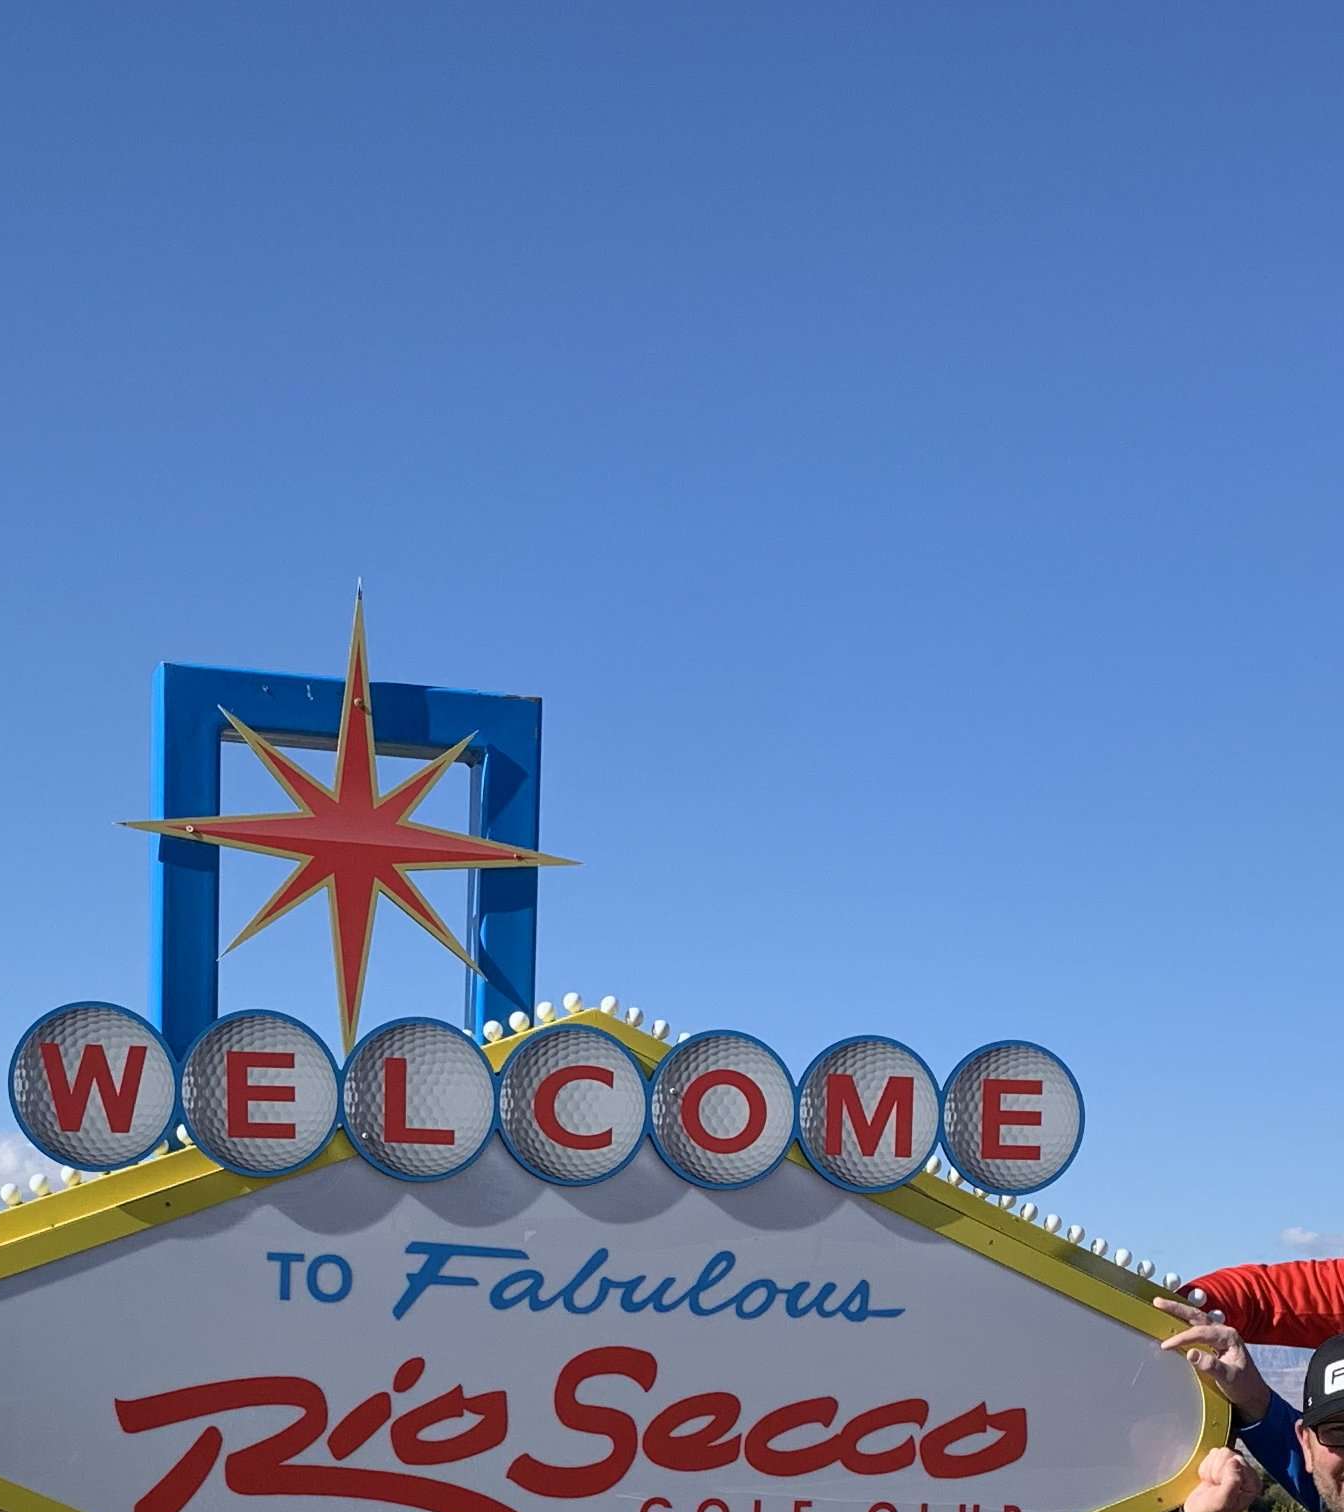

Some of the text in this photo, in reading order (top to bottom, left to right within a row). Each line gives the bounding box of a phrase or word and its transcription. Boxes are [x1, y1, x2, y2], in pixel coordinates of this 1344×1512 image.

[40, 1042, 1044, 1161] WELCOME
[265, 1239, 907, 1325] TO Fabulous
[506, 1346, 1028, 1499] Secco
